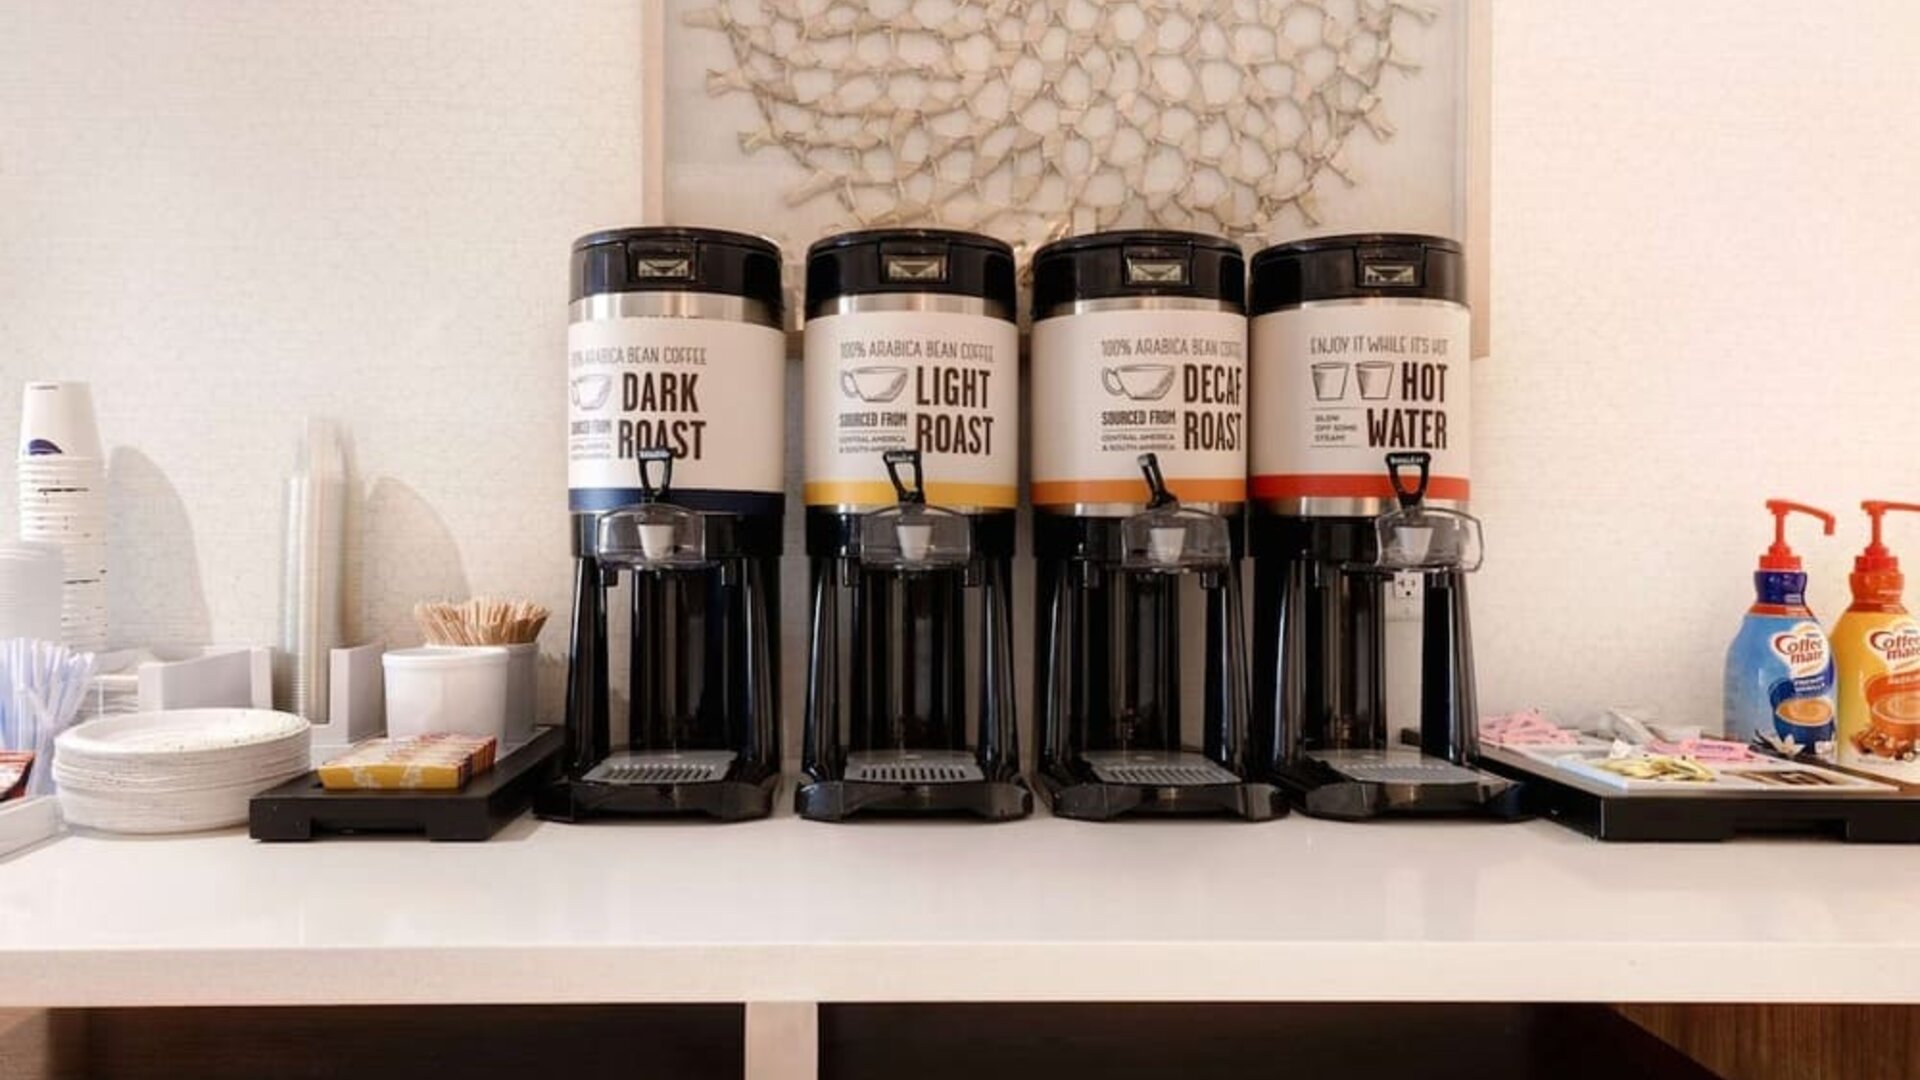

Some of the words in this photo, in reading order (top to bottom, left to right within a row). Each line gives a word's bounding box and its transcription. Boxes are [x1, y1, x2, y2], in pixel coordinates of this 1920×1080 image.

[627, 347, 659, 364] BEAN
[663, 347, 707, 365] COFFEE
[841, 342, 866, 360] 100%
[869, 341, 922, 358] ARABICA
[926, 341, 958, 359] BEAN
[961, 343, 994, 363] COFFEE
[1101, 340, 1132, 357] 100%
[1135, 338, 1188, 356] ARABICA
[1191, 340, 1218, 356] BEAN
[1310, 336, 1348, 355] ENJOY
[1353, 335, 1365, 353] IT
[1368, 336, 1406, 353] WHILE
[622, 372, 699, 413] DARK
[916, 366, 991, 409] LIGHT
[1183, 363, 1242, 406] DECAF
[1402, 361, 1448, 403] HOT
[839, 412, 878, 428] SOURCED
[881, 412, 908, 427] FROM
[916, 413, 994, 456] ROAST
[1102, 409, 1147, 426] SOURCED
[1150, 409, 1176, 425] FROM
[1183, 410, 1242, 451] ROAST
[1367, 408, 1447, 449] WATER
[618, 419, 706, 460] ROAST
